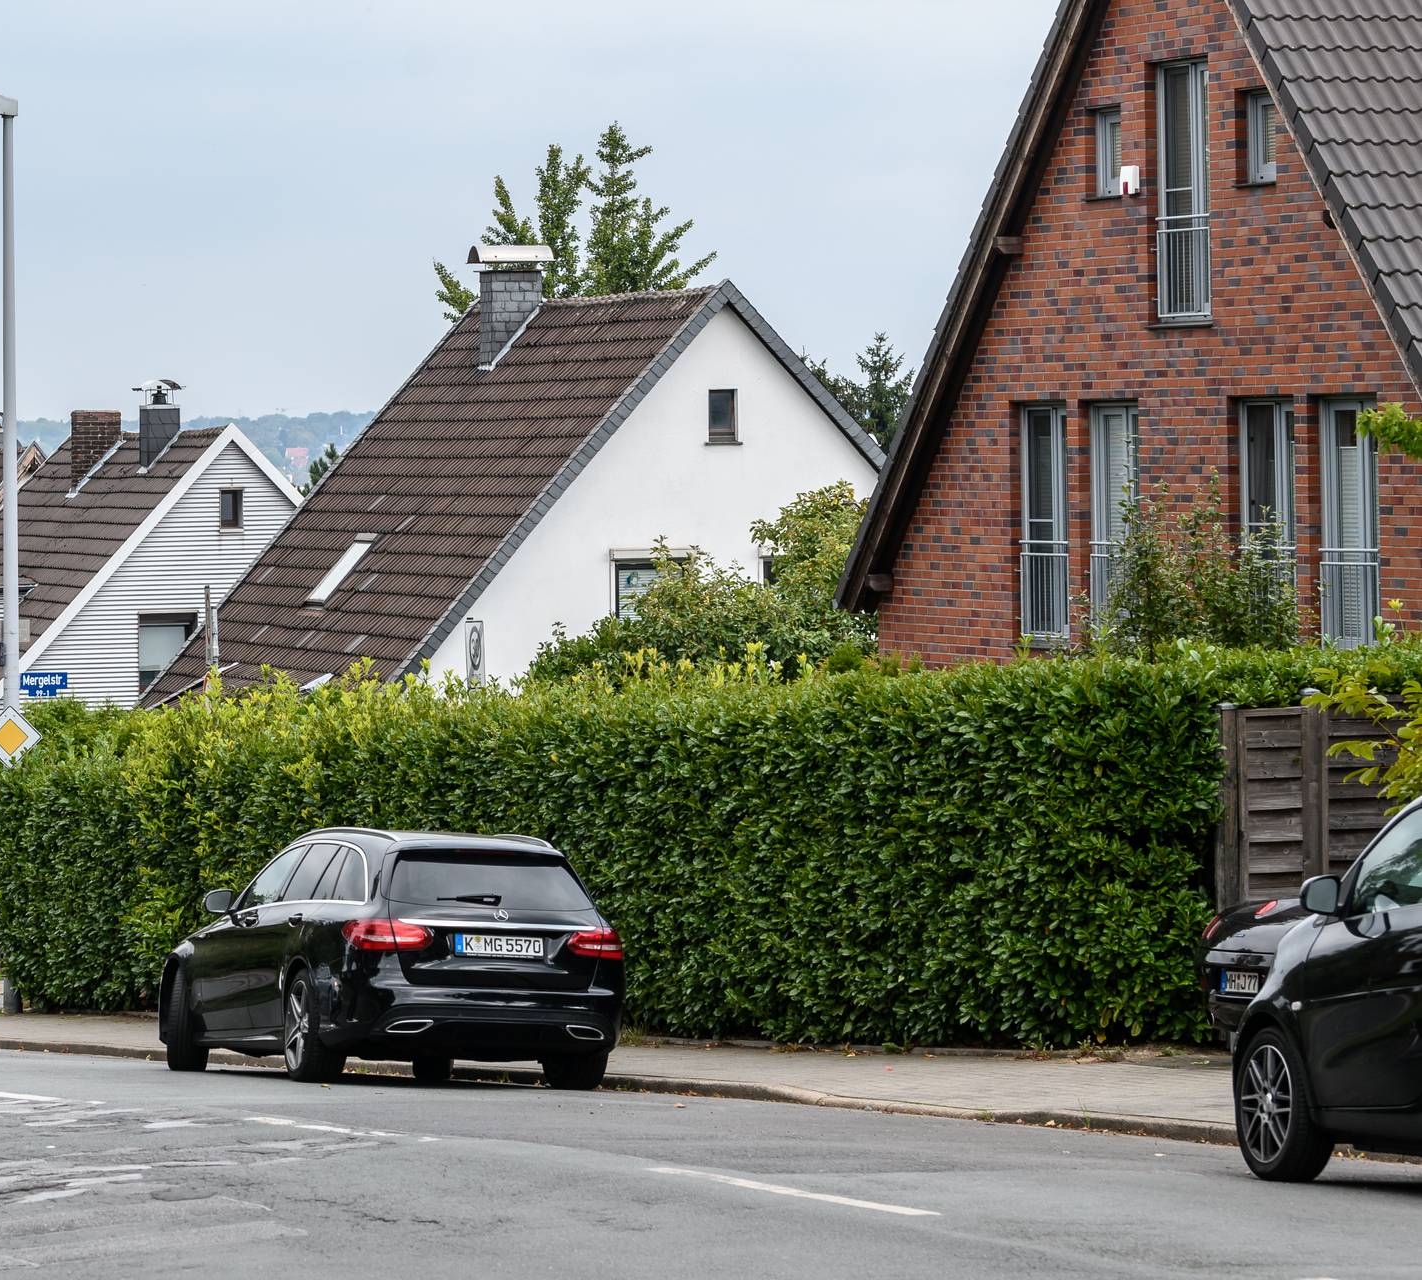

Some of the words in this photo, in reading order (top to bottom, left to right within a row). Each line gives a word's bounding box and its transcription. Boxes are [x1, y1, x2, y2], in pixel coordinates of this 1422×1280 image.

[22, 674, 66, 688] Mergelstr.
[464, 936, 474, 951] K
[484, 937, 503, 952] MG
[505, 938, 541, 954] 5570
